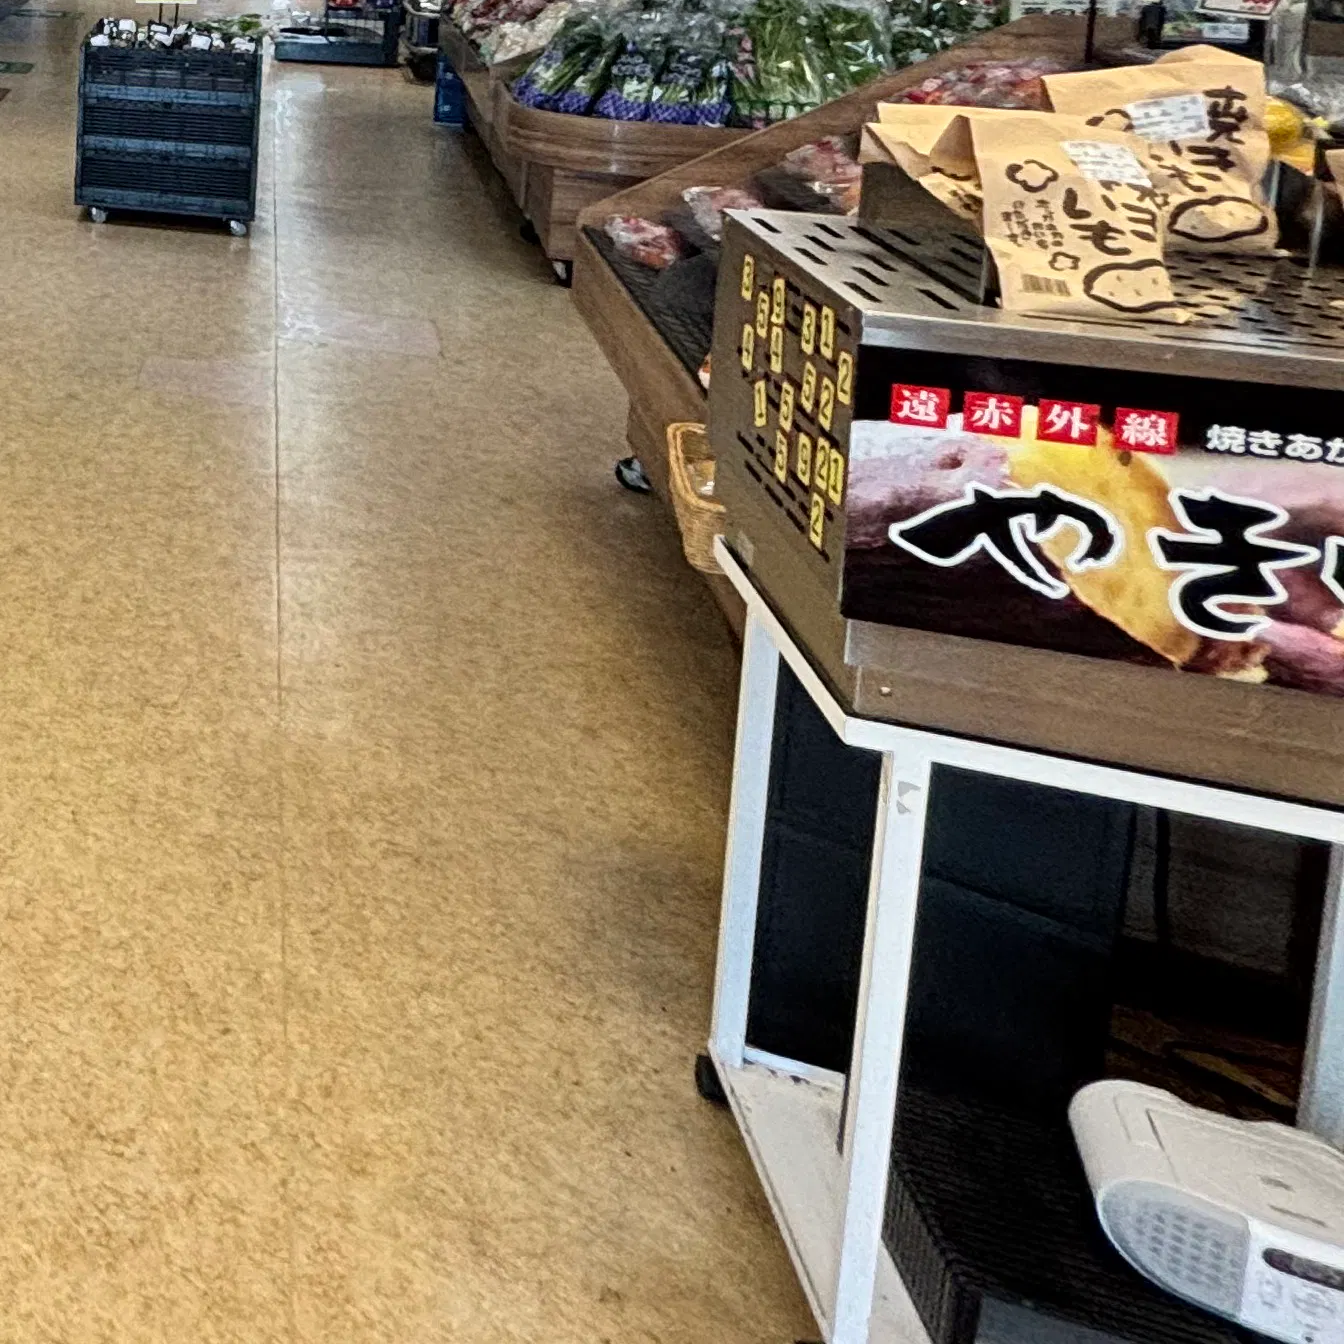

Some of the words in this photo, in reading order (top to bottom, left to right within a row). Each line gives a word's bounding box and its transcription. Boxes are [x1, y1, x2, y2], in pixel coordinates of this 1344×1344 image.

[897, 389, 1169, 448] 遠赤外線
[889, 482, 1344, 640] やき
